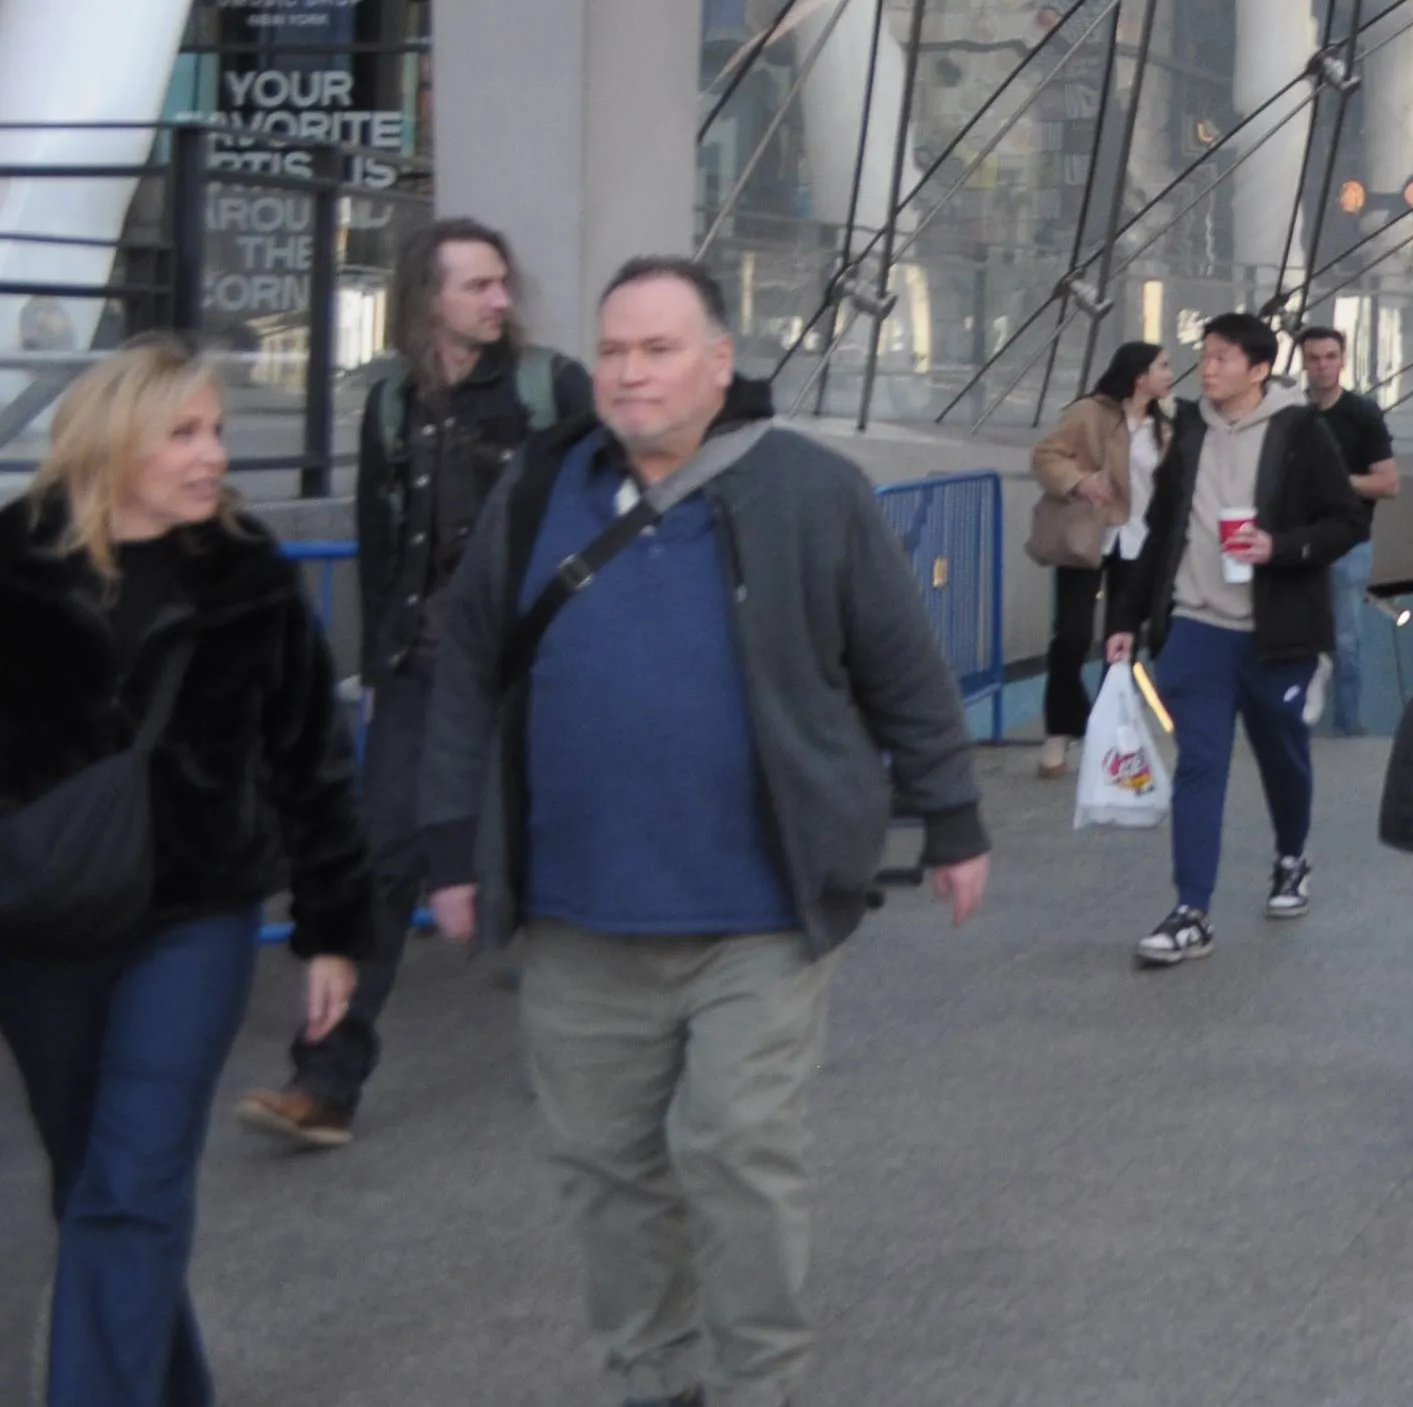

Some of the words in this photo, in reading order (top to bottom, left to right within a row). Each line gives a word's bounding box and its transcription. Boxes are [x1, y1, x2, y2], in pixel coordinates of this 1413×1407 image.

[289, 12, 330, 27] YORK
[224, 70, 354, 107] YOUR
[352, 154, 397, 189] IS
